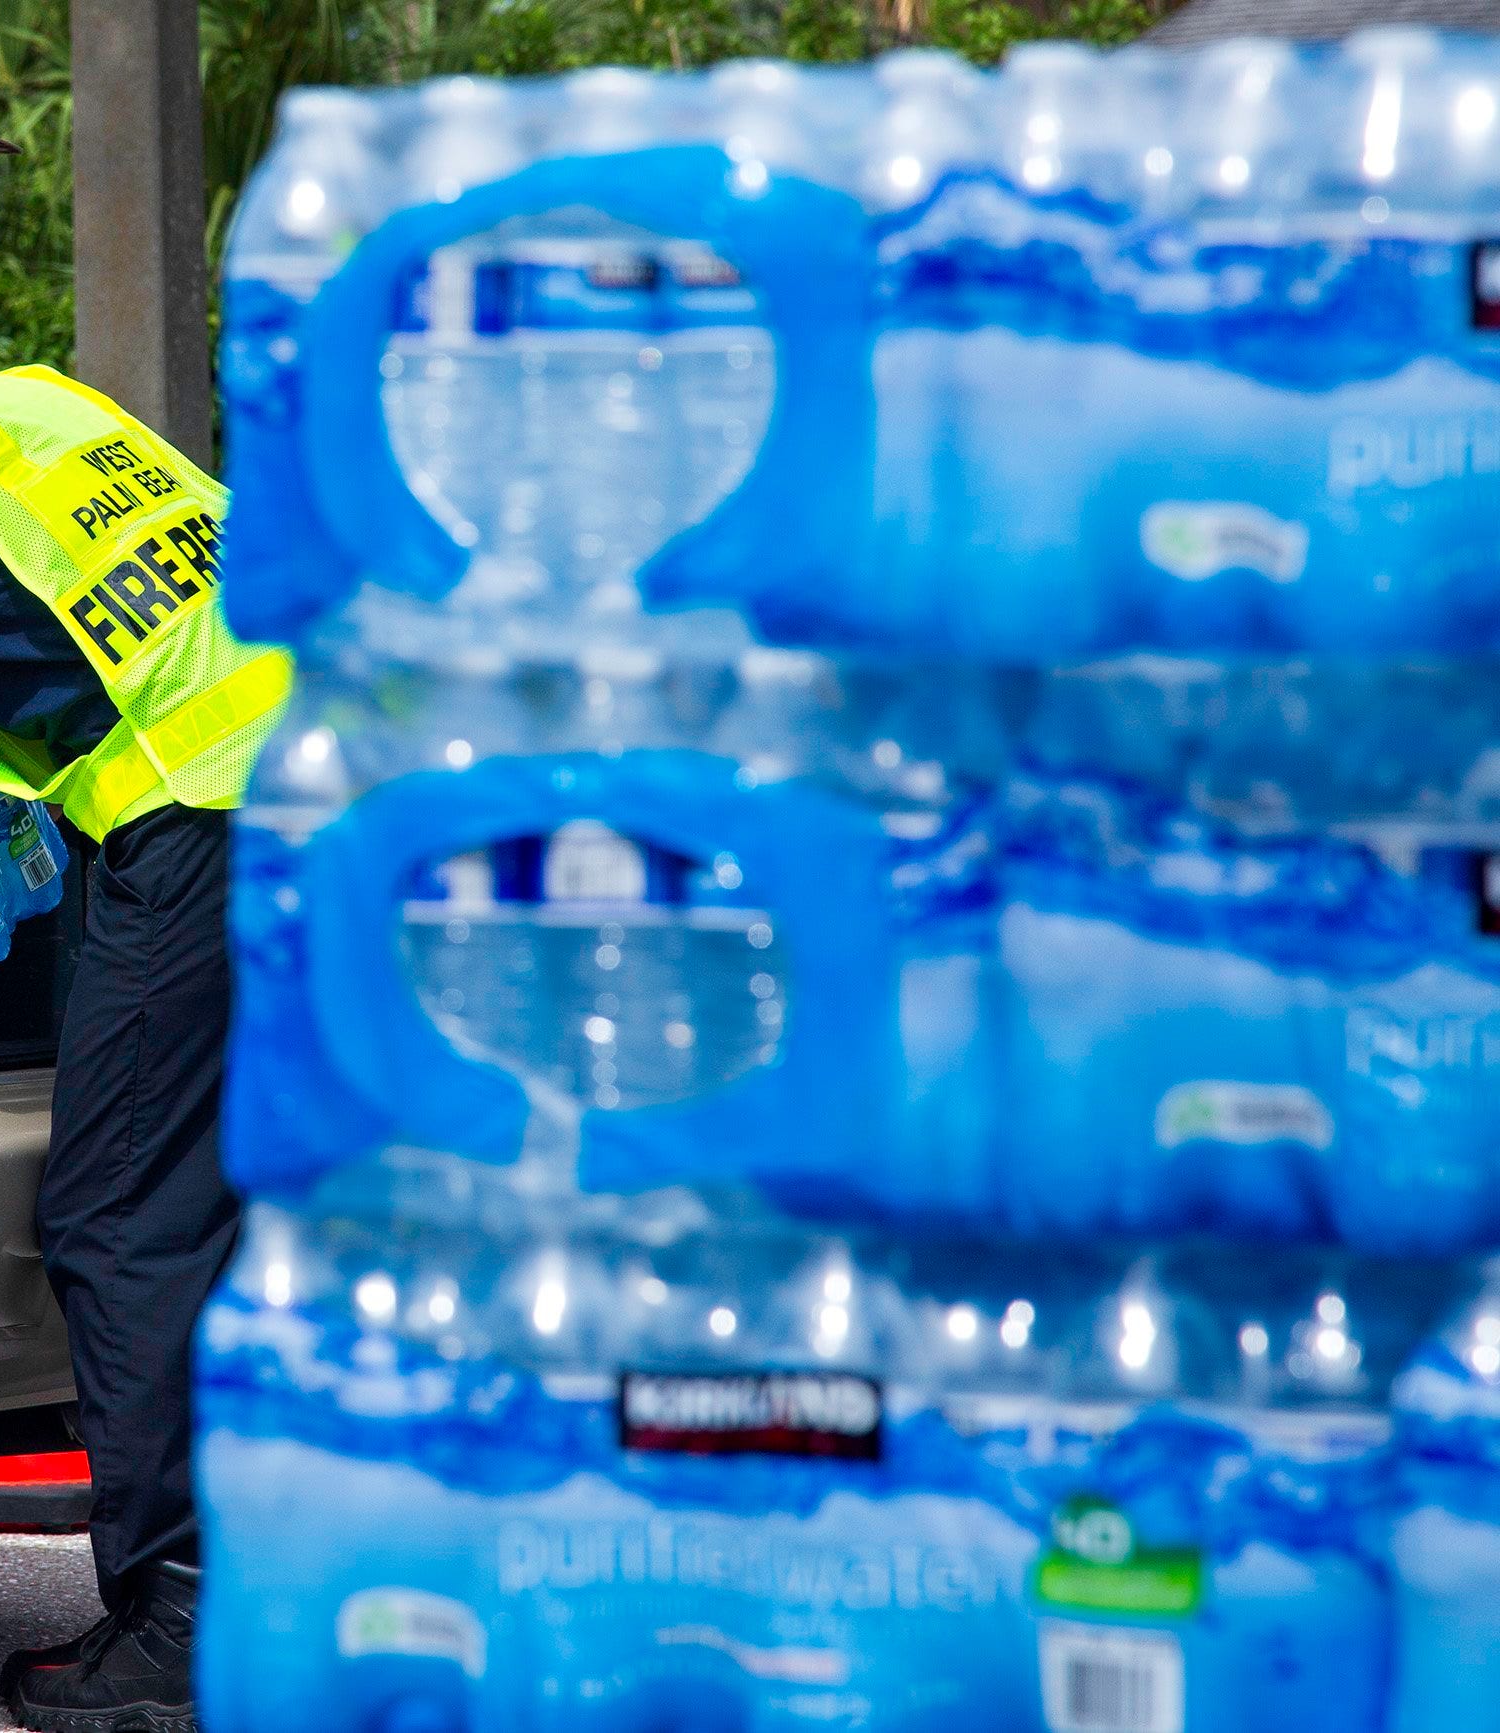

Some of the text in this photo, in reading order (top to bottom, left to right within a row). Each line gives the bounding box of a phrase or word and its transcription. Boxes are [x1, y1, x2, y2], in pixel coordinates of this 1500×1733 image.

[79, 440, 143, 478] WEST
[68, 537, 201, 666] FIRE
[10, 814, 34, 837] 40
